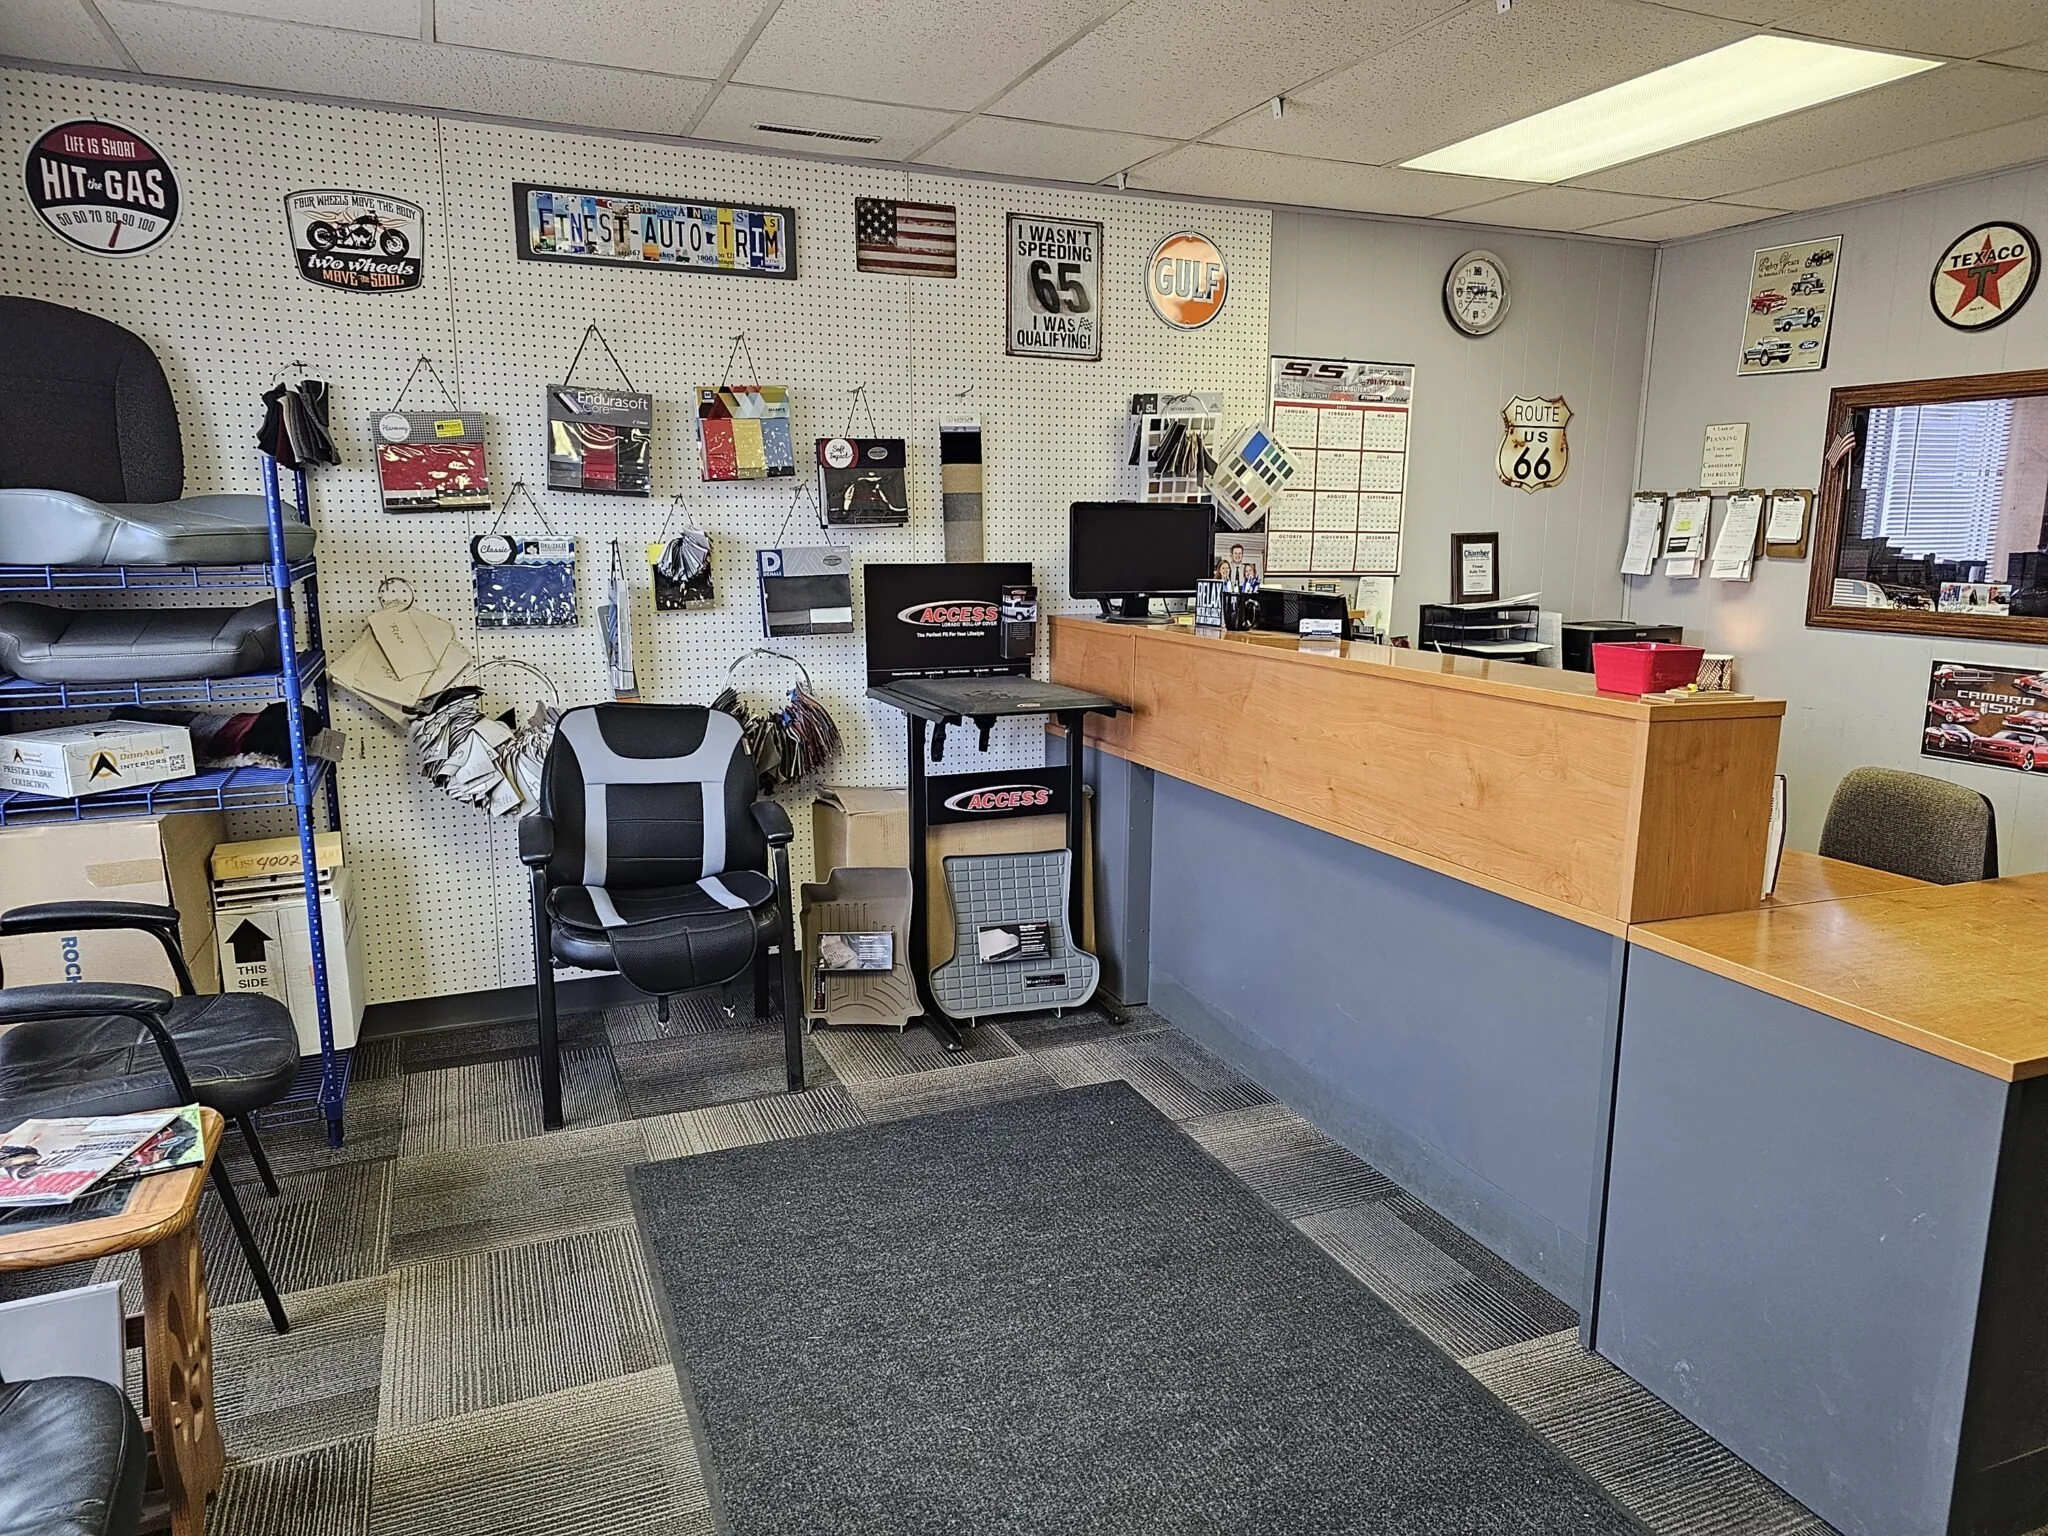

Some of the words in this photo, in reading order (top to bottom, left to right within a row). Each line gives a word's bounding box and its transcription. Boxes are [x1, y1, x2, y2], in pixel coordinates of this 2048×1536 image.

[64, 134, 85, 153] LIFE
[87, 138, 99, 154] IS
[101, 138, 136, 158] SHORT
[40, 157, 88, 200] HIT
[87, 178, 103, 190] the
[104, 168, 165, 210] GAS
[294, 196, 316, 209] FOUR
[316, 195, 349, 207] WHEELS
[351, 196, 375, 208] MOVE
[377, 200, 395, 213] THE
[396, 204, 416, 220] BODY
[56, 212, 73, 226] 50
[72, 210, 88, 223] 60
[88, 210, 102, 222] 70
[105, 210, 118, 223] 80
[122, 213, 135, 227] 90
[137, 217, 156, 233] 100
[1018, 224, 1022, 240] I
[1030, 225, 1092, 246] WASN'T
[1018, 241, 1092, 262] SPEEDING
[1950, 244, 2024, 268] TEXACO
[308, 253, 344, 269] two
[348, 258, 415, 275] wheels
[322, 269, 358, 286] MOVE
[370, 272, 404, 287] SOUL
[1030, 259, 1091, 314] 65
[1155, 257, 1220, 303] GULF
[1968, 263, 1999, 296] T
[1033, 316, 1038, 330] I
[1042, 317, 1076, 333] WAS
[1016, 330, 1092, 350] QUALIFYING!
[577, 392, 648, 410] Endurasoft
[582, 402, 610, 414] Core
[1514, 405, 1560, 422] ROUTE
[382, 424, 411, 433] Harmony
[1524, 431, 1548, 443] US
[829, 452, 851, 461] Impact
[832, 444, 845, 452] Soft
[1513, 446, 1552, 480] 66
[480, 545, 512, 554] Classic
[1464, 550, 1490, 558] Chamber
[761, 552, 780, 572] D
[1197, 582, 1222, 608] RELAX
[920, 606, 999, 622] ACCESS
[1957, 690, 2037, 706] CAMARO
[3, 764, 31, 776] PRESTIGE
[32, 768, 55, 779] FABRIC
[120, 758, 167, 770] INTERIORS
[12, 778, 50, 790] COLLECTION
[967, 790, 1049, 810] ACCESS
[257, 854, 300, 870] 4002
[236, 965, 267, 976] THIS
[238, 978, 269, 989] SIDE
